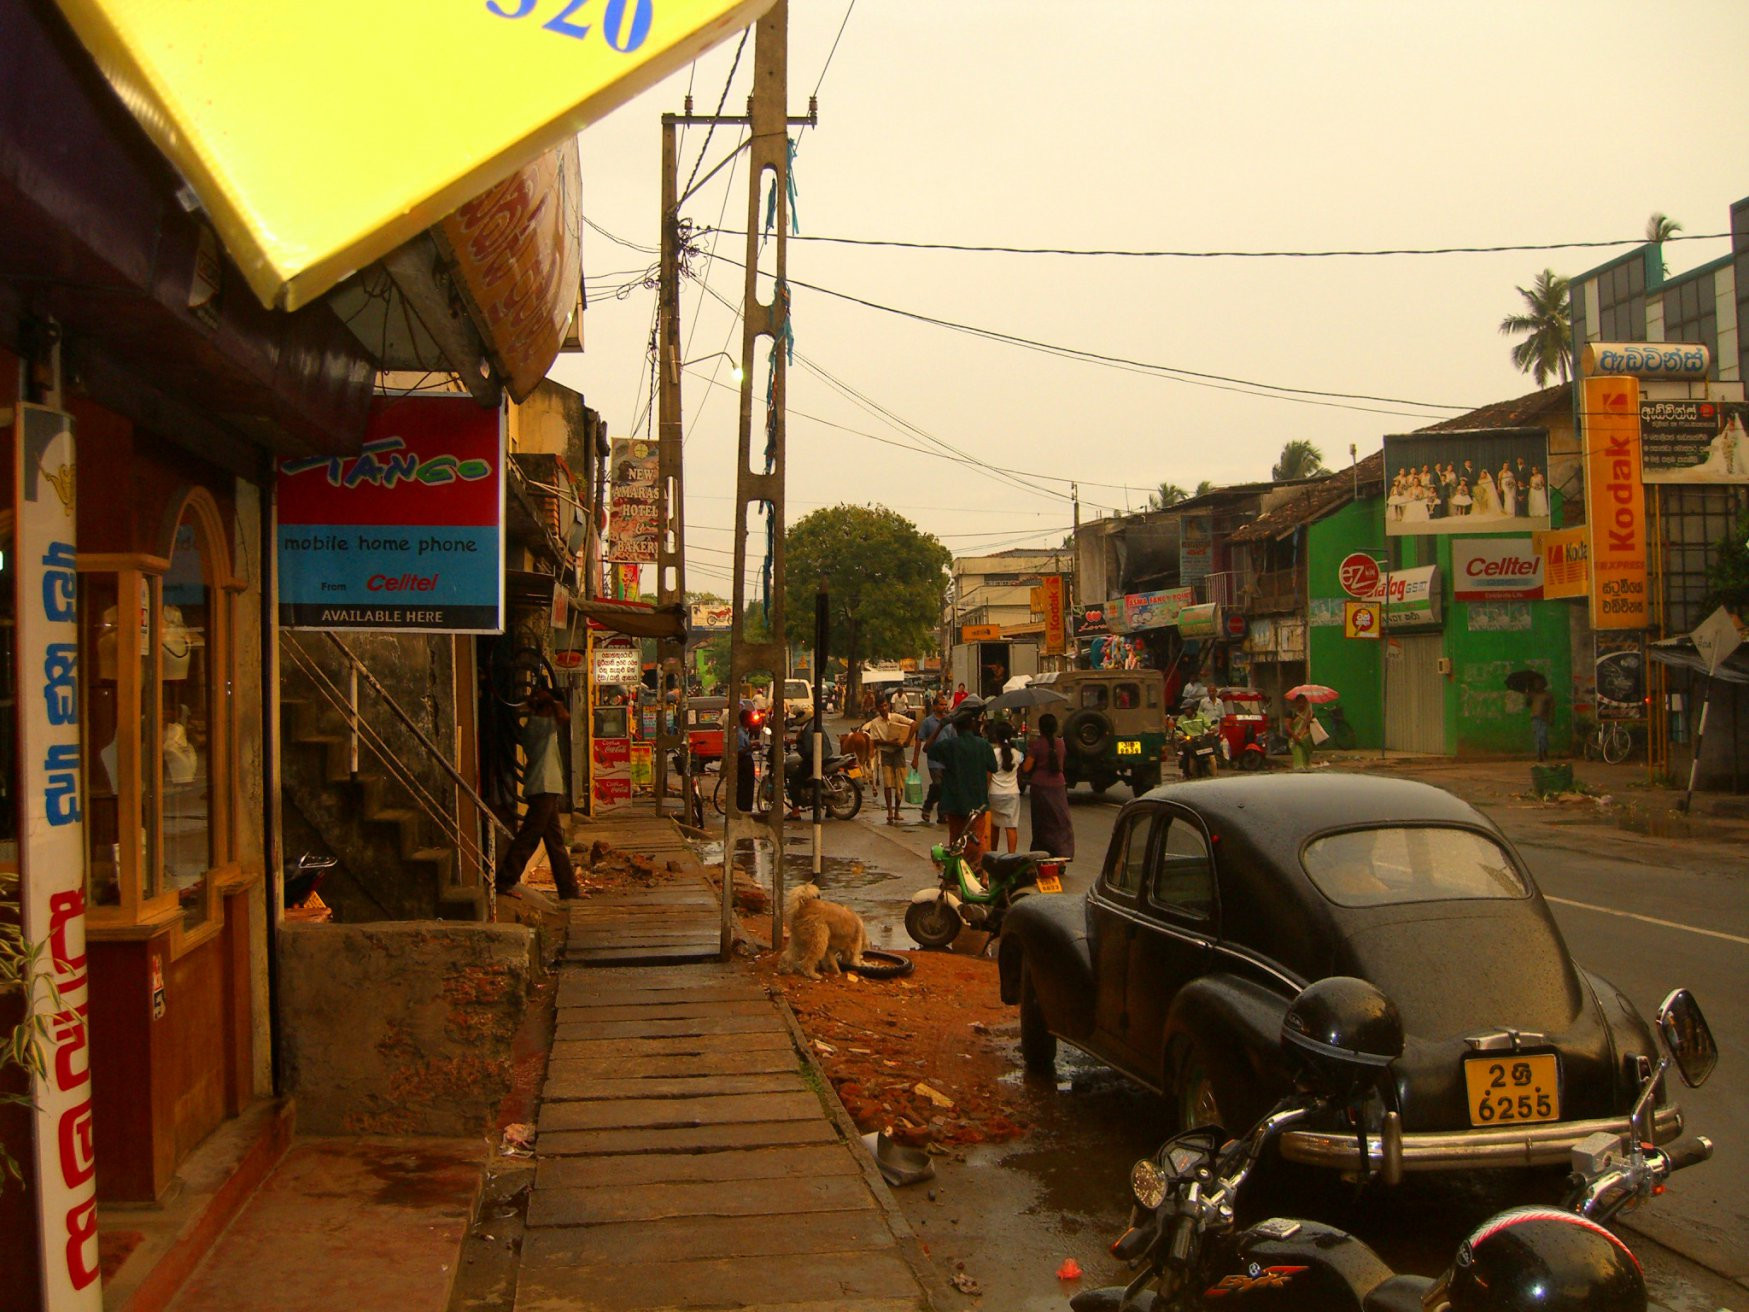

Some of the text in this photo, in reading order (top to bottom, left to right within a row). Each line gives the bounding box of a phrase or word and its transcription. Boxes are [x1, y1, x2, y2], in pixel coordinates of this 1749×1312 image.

[485, 0, 654, 53] 20
[281, 436, 492, 489] TANGO
[628, 468, 653, 480] NEW
[1603, 435, 1636, 552] Kodak
[622, 504, 658, 517] HOTEL
[285, 535, 478, 555] mobile home phone
[1565, 541, 1588, 563] Koda
[1465, 557, 1541, 577] Celltel
[320, 573, 440, 592] From Celltel
[322, 610, 443, 623] AVAILABLE HERE
[1049, 591, 1060, 631] Kodak
[1478, 1094, 1552, 1121] 6255
